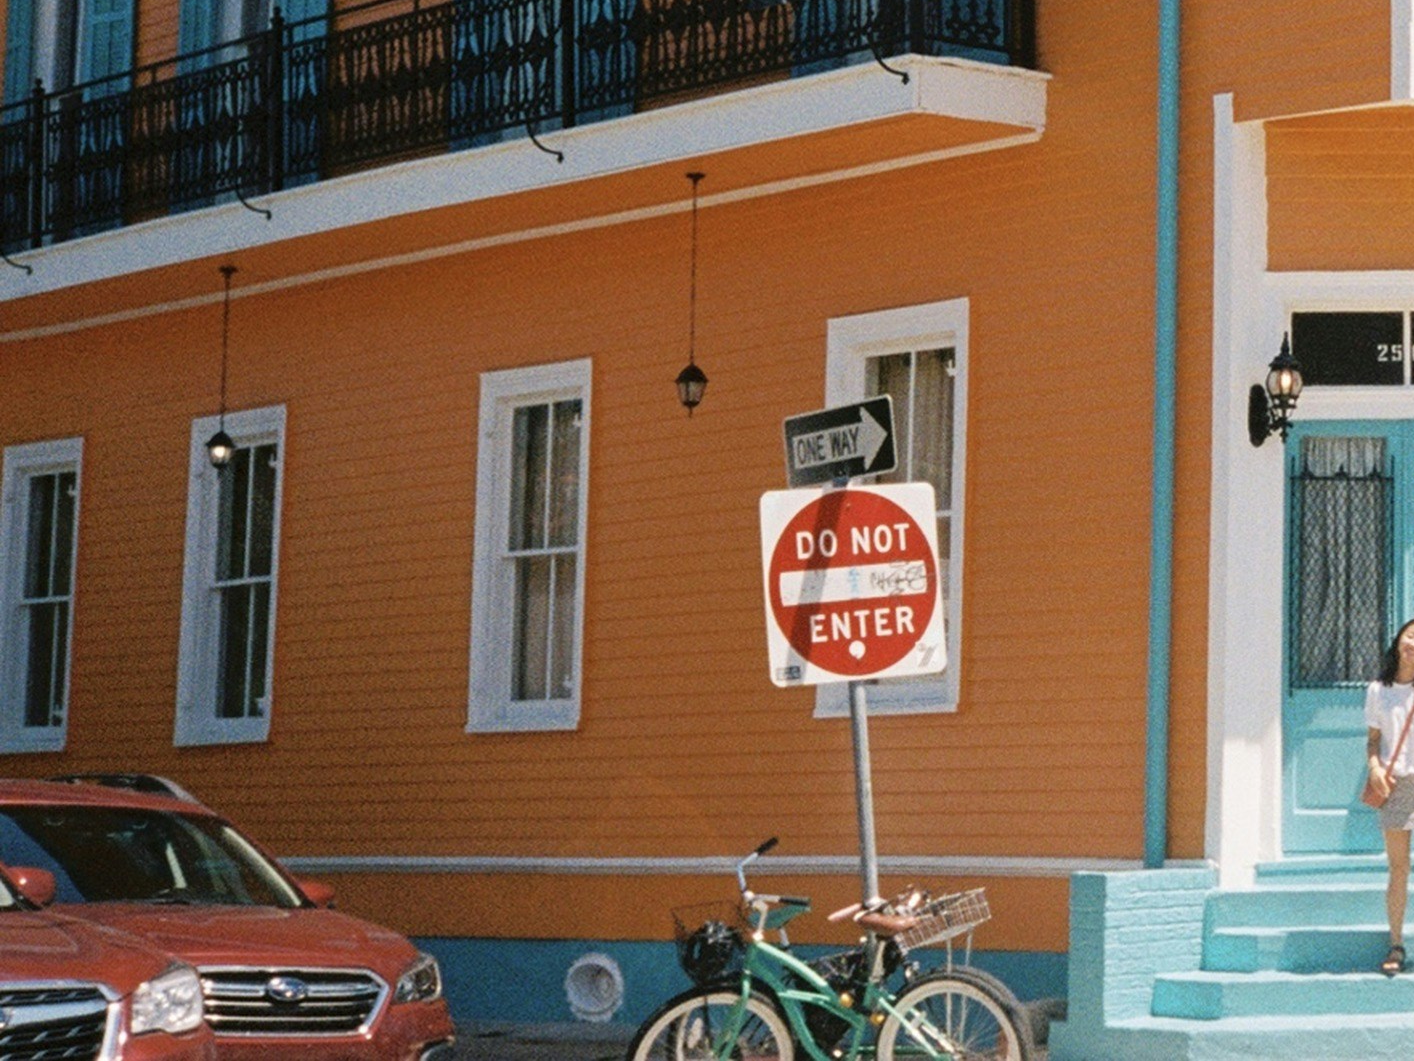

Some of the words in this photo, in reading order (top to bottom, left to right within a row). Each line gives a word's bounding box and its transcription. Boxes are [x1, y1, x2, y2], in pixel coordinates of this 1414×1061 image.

[797, 434, 826, 465] ONE
[829, 426, 859, 458] WAY
[796, 529, 838, 560] DO
[851, 523, 910, 555] NOT
[809, 606, 915, 643] ENTER
